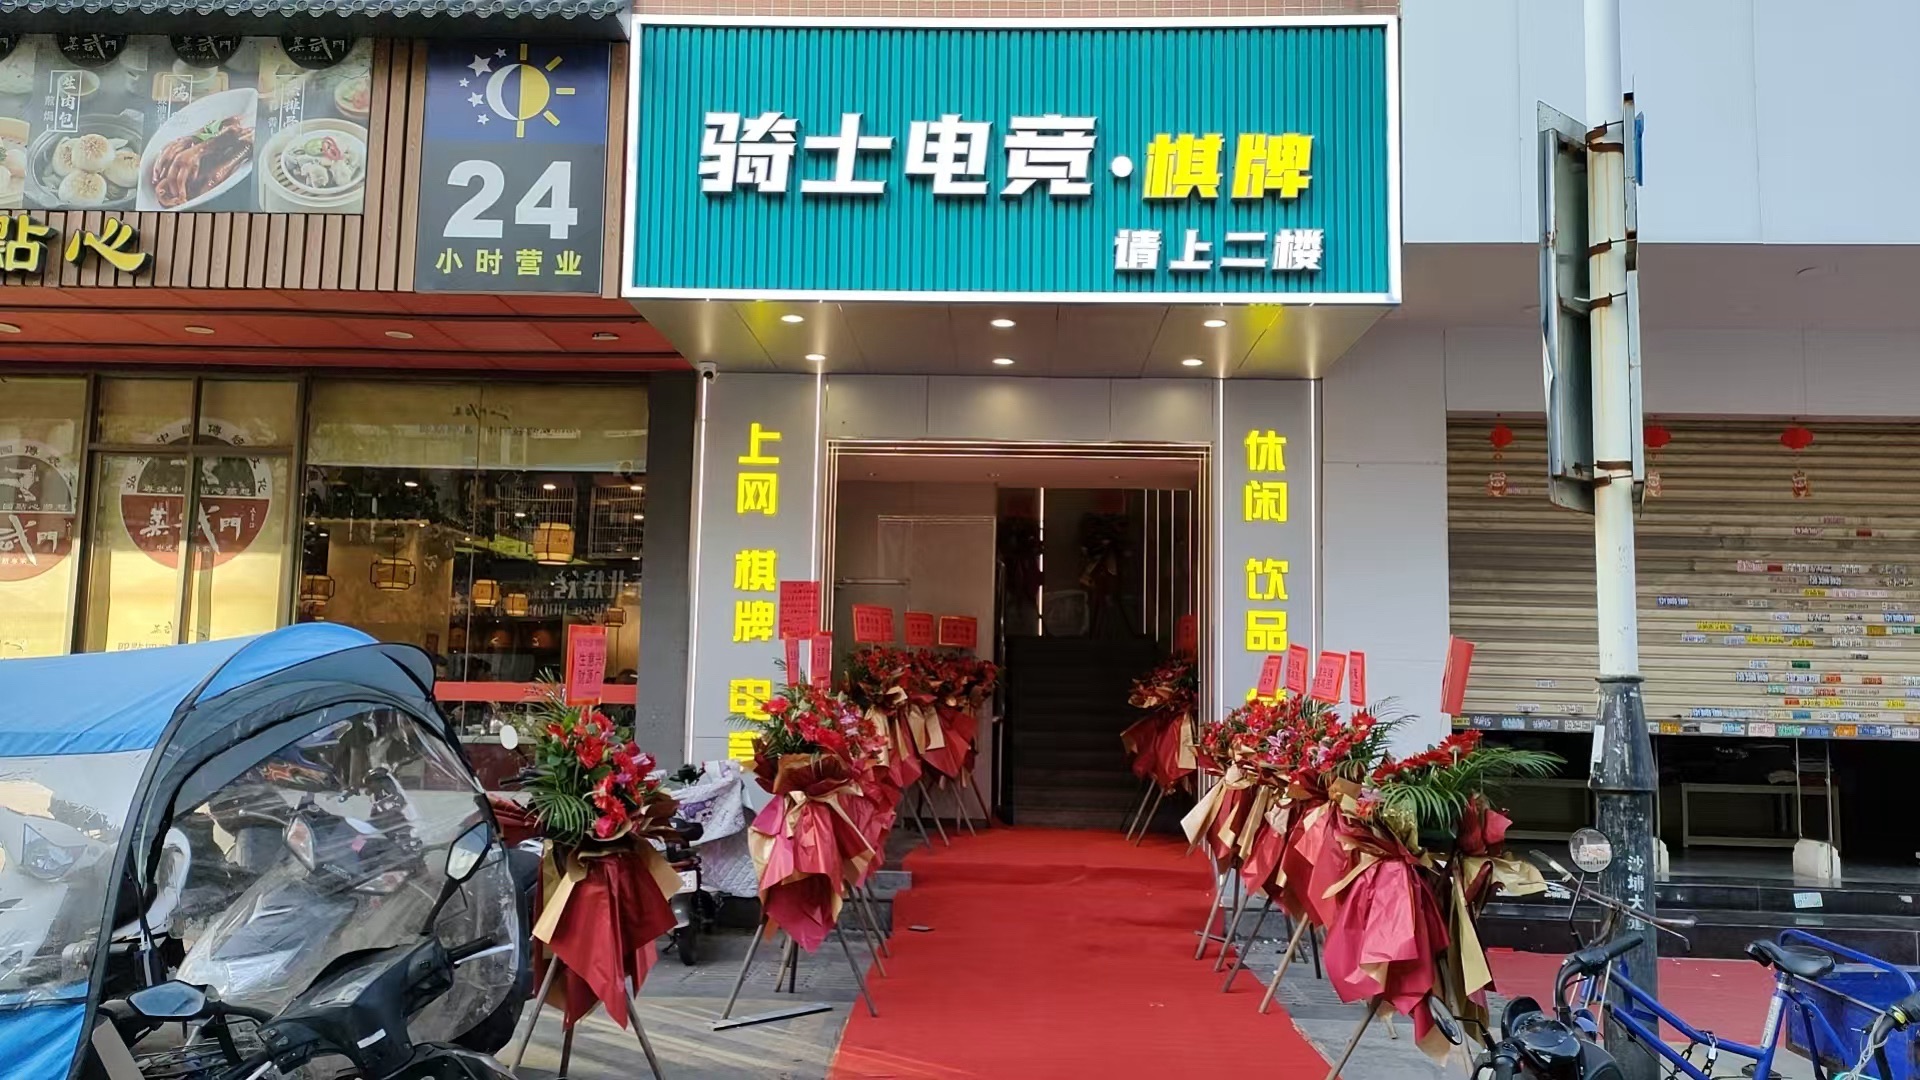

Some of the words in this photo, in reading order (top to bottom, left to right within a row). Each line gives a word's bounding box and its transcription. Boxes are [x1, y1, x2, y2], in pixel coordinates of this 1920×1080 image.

[59, 76, 77, 128] 生肉包
[443, 160, 578, 239] 24
[435, 248, 582, 276] 小时营业
[1114, 229, 1324, 272] 请上二楼
[736, 423, 782, 516] 上网
[1244, 430, 1287, 522] 休闲
[733, 550, 777, 642] 棋牌
[1245, 558, 1289, 651] 饮品
